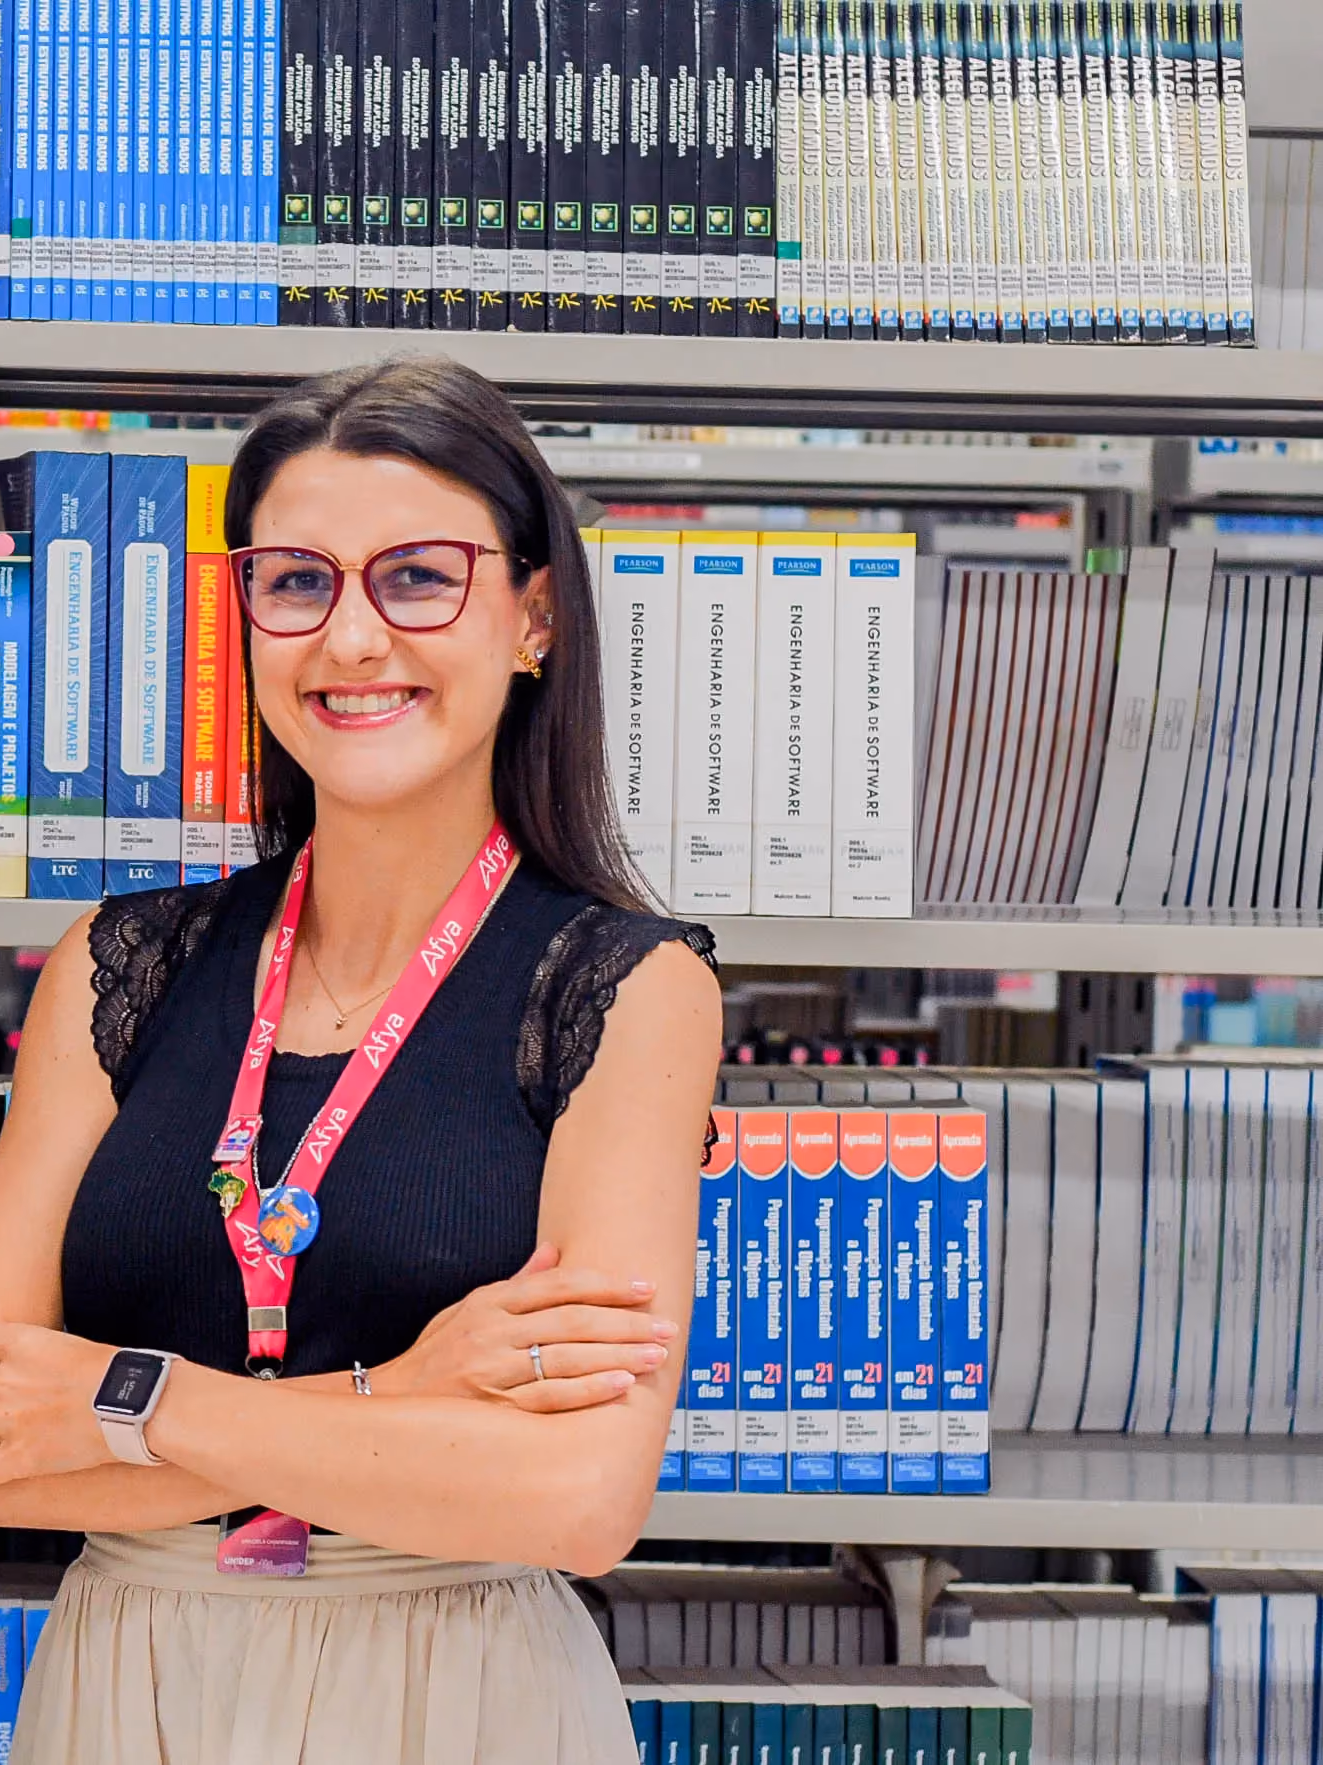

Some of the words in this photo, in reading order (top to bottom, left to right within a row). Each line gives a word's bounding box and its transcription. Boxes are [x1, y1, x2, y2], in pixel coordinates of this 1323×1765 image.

[37, 46, 49, 115] ESTRUTURAS
[263, 52, 275, 121] ESTRUTURAS
[285, 67, 294, 131] FUNDAMENTOS
[295, 53, 304, 100] SOFTWARE
[304, 65, 313, 121] ENGENHARIA
[679, 65, 687, 113] SOFTWARE
[37, 117, 48, 130] DE
[263, 122, 274, 136] DE
[294, 102, 303, 145] APLICADA
[304, 123, 312, 134] DE
[669, 79, 677, 143] FUNDAMENTOS
[688, 77, 696, 132] ENGENHARIA
[778, 53, 798, 176] ALGORITMOS
[847, 54, 867, 177] ALGORITMOS
[895, 57, 916, 180] ALGORITMOS
[1197, 58, 1218, 181] ALGORITMOS
[1221, 57, 1243, 180] ALGORITMOS
[37, 134, 48, 170] DADOS
[263, 140, 273, 176] DADOS
[678, 114, 686, 157] APLICADA
[687, 134, 695, 146] DE
[619, 559, 659, 569] PEARSON
[700, 560, 738, 569] PEARSON
[778, 561, 817, 570] PEARSON
[855, 562, 894, 572] PEARSON
[67, 551, 83, 651] ENGENHARIA
[144, 554, 159, 654] ENGENHARIA
[198, 564, 218, 660] ENGENHARIA
[2, 641, 18, 718] MODELAGEM
[66, 656, 81, 676] DE
[144, 660, 157, 680] DE
[197, 664, 216, 683] DE
[630, 603, 645, 708] ENGENHARIA
[710, 604, 724, 709] ENGENHARIA
[790, 604, 803, 710] ENGENHARIA
[867, 606, 881, 712] ENGENHARIA
[66, 681, 80, 762] SOFTWARE
[142, 684, 157, 765] SOFTWARE
[196, 687, 215, 762] SOFTWARE
[630, 713, 641, 729] DE
[710, 713, 721, 729] DE
[790, 715, 800, 731] DE
[868, 717, 879, 732] DE
[1, 734, 17, 802] PROJETOS
[627, 733, 643, 815] SOFTWARE
[708, 734, 722, 815] SOFTWARE
[787, 735, 801, 817] SOFTWARE
[866, 736, 880, 818] SOFTWARE
[52, 865, 77, 875] LTC
[129, 868, 154, 879] LTC
[477, 834, 510, 890] Afya
[420, 920, 463, 977] Afya
[250, 1018, 276, 1070] Afya
[364, 1012, 405, 1069] Afya
[307, 1107, 348, 1164] Afya
[744, 1133, 782, 1147] Aprenda
[943, 1135, 981, 1148] Aprenda
[235, 1220, 263, 1269] Afy
[747, 1240, 759, 1248] a
[764, 1199, 782, 1278] Programação
[947, 1241, 958, 1249] a
[964, 1200, 982, 1279] Programação
[743, 1251, 762, 1298] Objetos
[943, 1252, 962, 1299] Objetos
[767, 1281, 782, 1339] Orientada
[967, 1281, 983, 1340] Orientada
[744, 1370, 762, 1382] em
[764, 1363, 782, 1383] 21
[749, 1385, 776, 1399] dias
[944, 1370, 963, 1382] em
[965, 1363, 983, 1384] 21
[950, 1385, 976, 1399] dias
